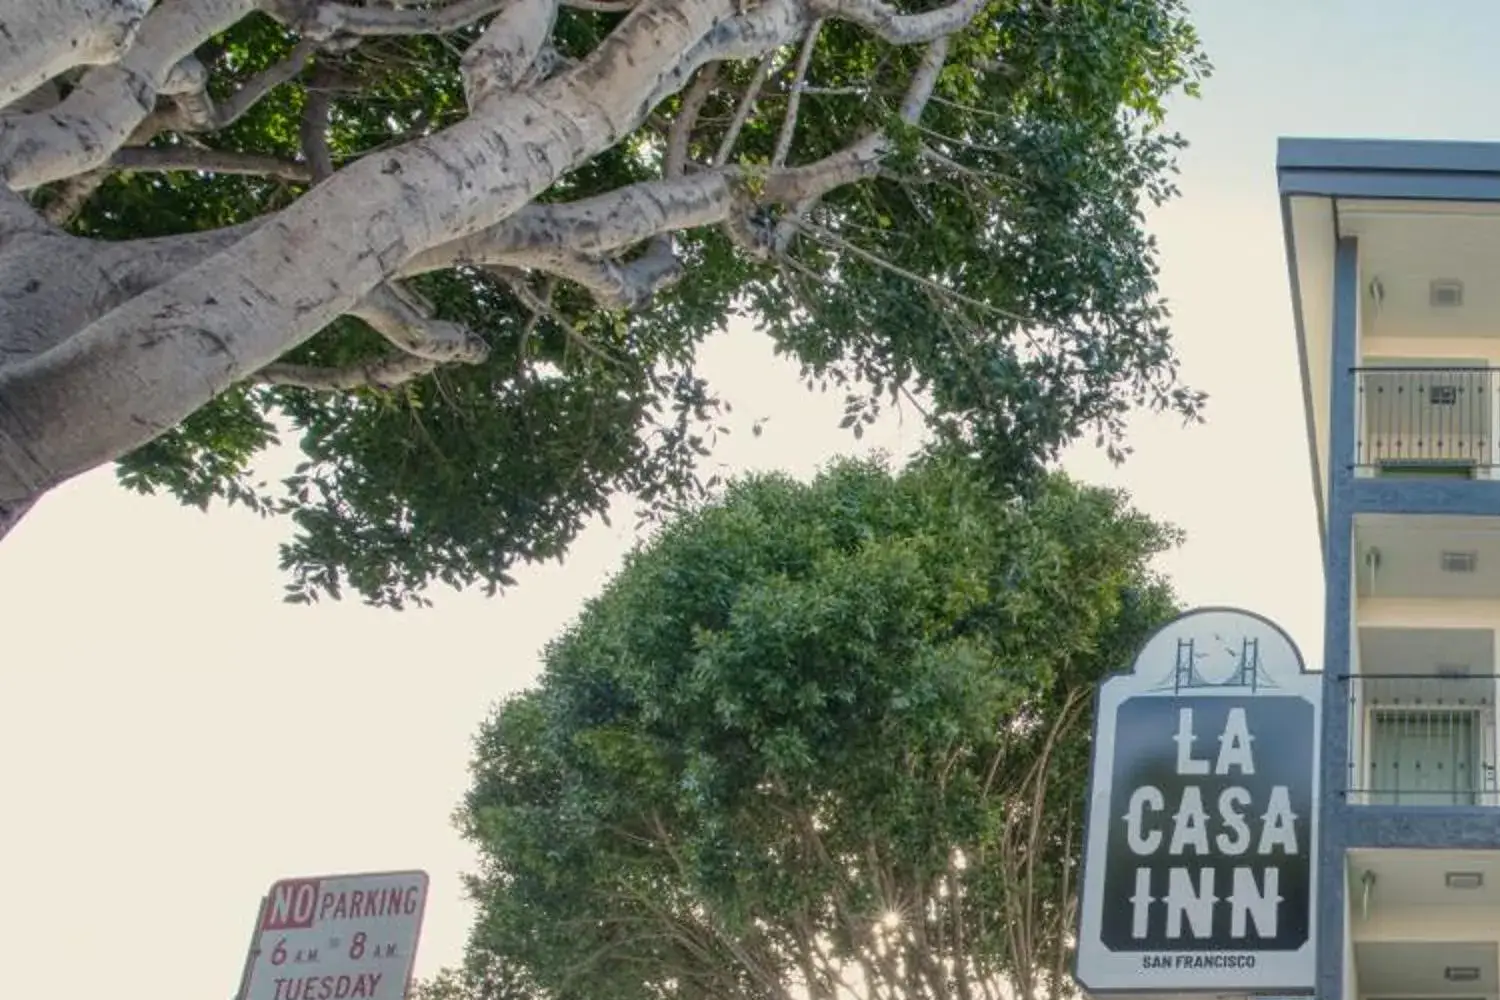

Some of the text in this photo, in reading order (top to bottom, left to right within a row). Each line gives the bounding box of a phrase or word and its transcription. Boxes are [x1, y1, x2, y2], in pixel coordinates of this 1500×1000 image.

[1173, 708, 1256, 775] LA
[1122, 786, 1298, 856] CASA
[270, 883, 418, 925] NO PARKING
[1129, 867, 1284, 939] INN
[271, 937, 287, 966] 6
[349, 931, 368, 960] 8
[1143, 955, 1256, 968] SAN FRANCISCO
